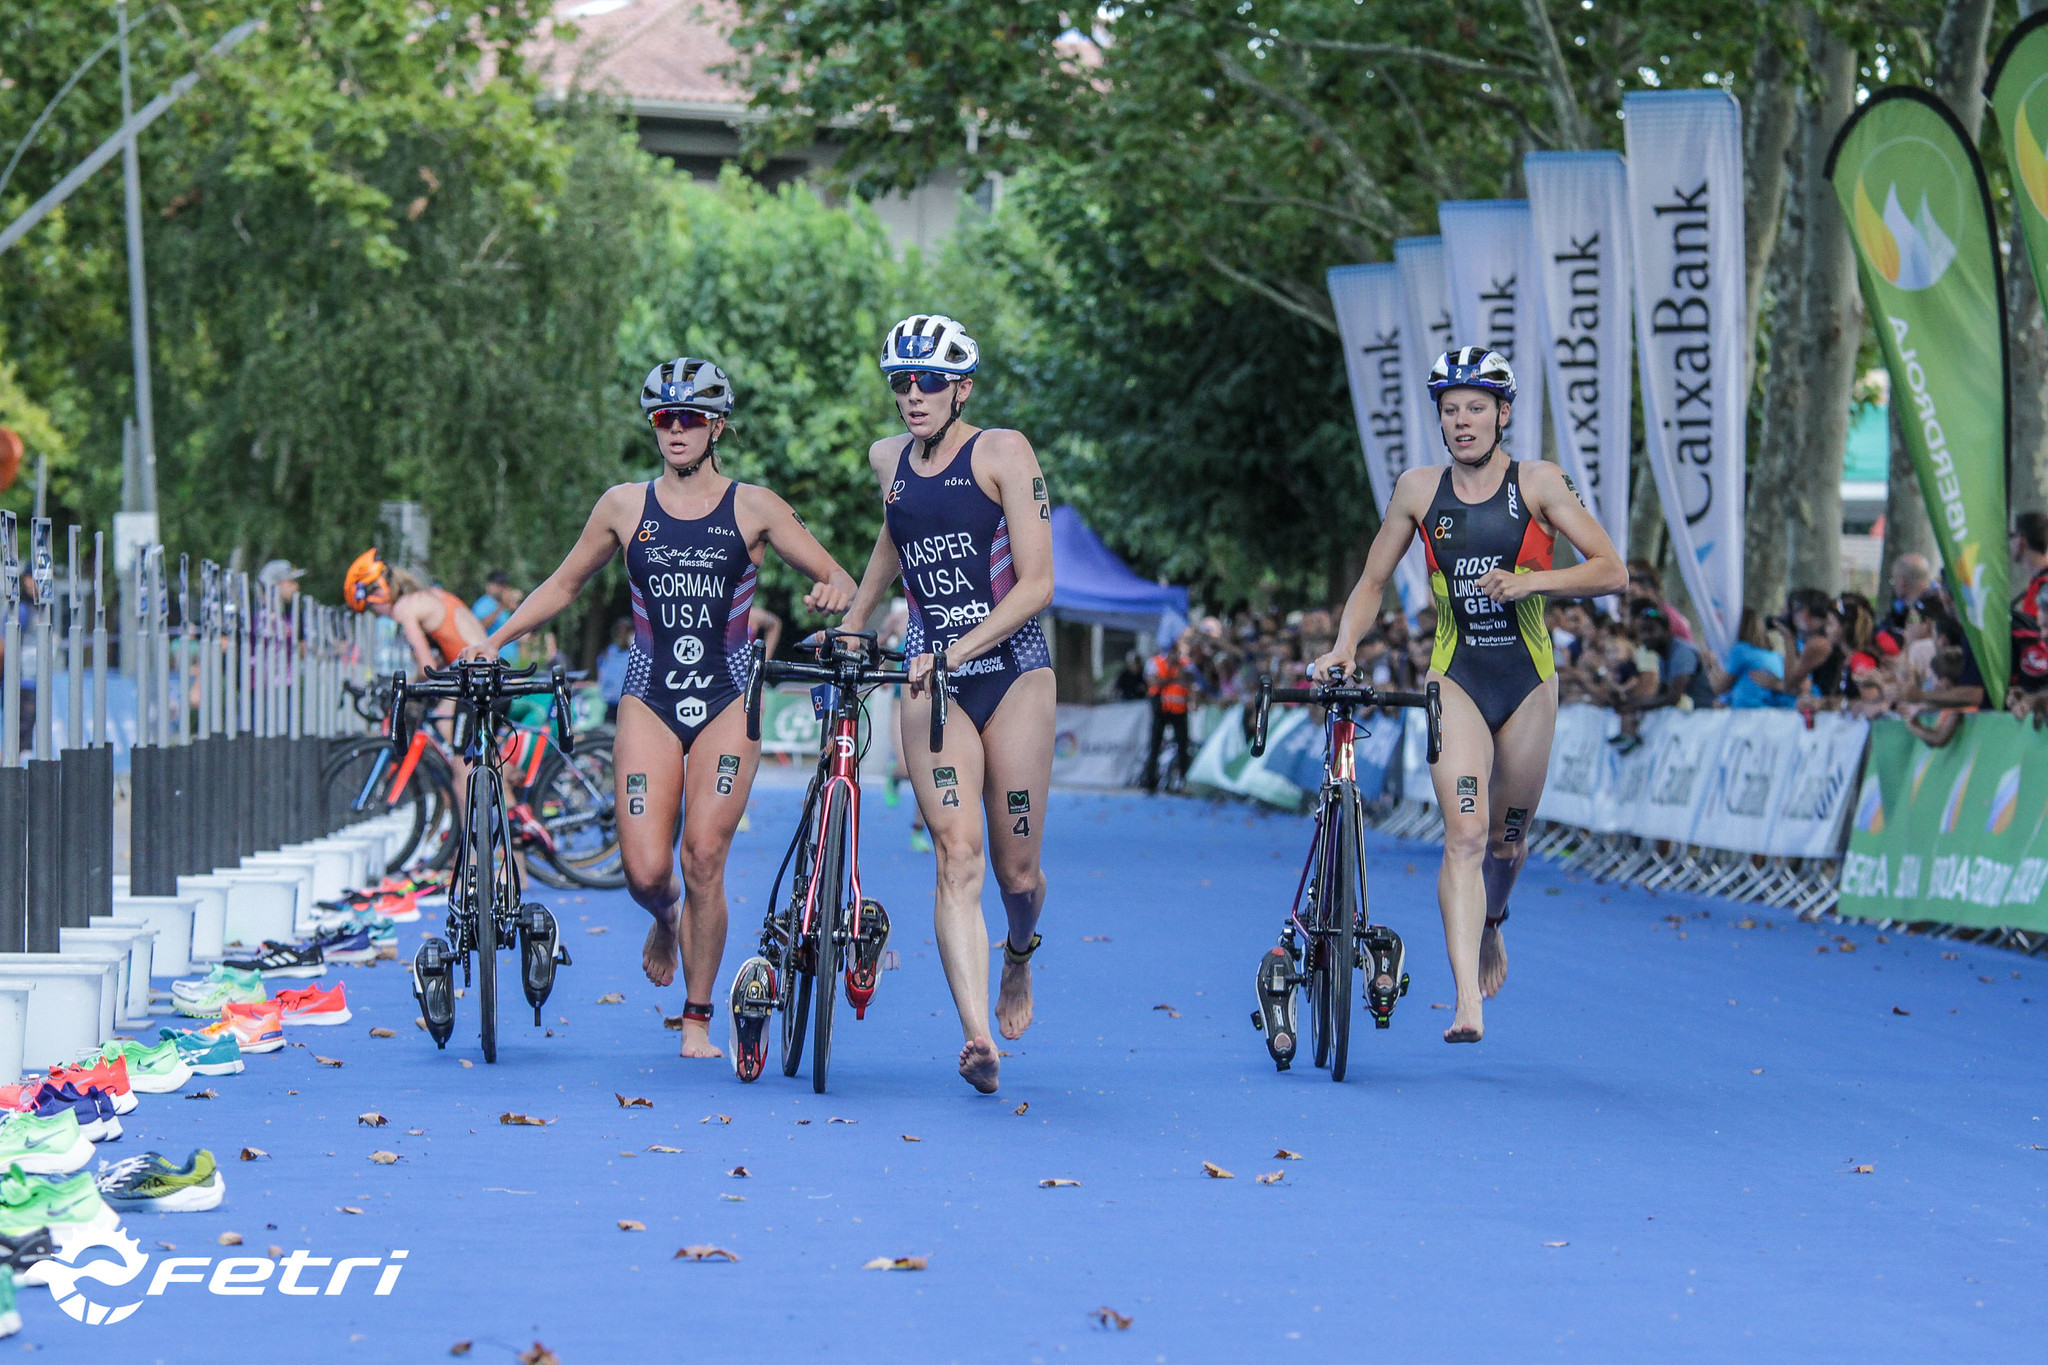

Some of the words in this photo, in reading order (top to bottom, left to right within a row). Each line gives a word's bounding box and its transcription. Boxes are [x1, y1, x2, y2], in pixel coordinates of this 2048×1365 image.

[906, 339, 914, 352] 4
[1653, 178, 1713, 526] CaixaBank
[1455, 367, 1462, 379] 2
[669, 385, 676, 397] 6
[1507, 482, 1519, 520] 2XU
[901, 532, 978, 570] KASPER
[679, 559, 714, 569] MASSAGE
[1453, 555, 1503, 576] ROSE
[648, 573, 726, 598] GORMAN
[917, 567, 974, 598] USA
[661, 603, 713, 628] USA
[1464, 597, 1504, 615] GER
[949, 617, 988, 628] ELEMEN
[947, 660, 985, 677] OKA
[982, 656, 1002, 666] ONE
[679, 706, 703, 717] GU
[716, 775, 734, 795] 6
[628, 797, 646, 816] 6
[941, 788, 960, 808] 4
[1460, 797, 1475, 814] 2
[1012, 815, 1030, 837] 4
[1503, 827, 1521, 842] 2
